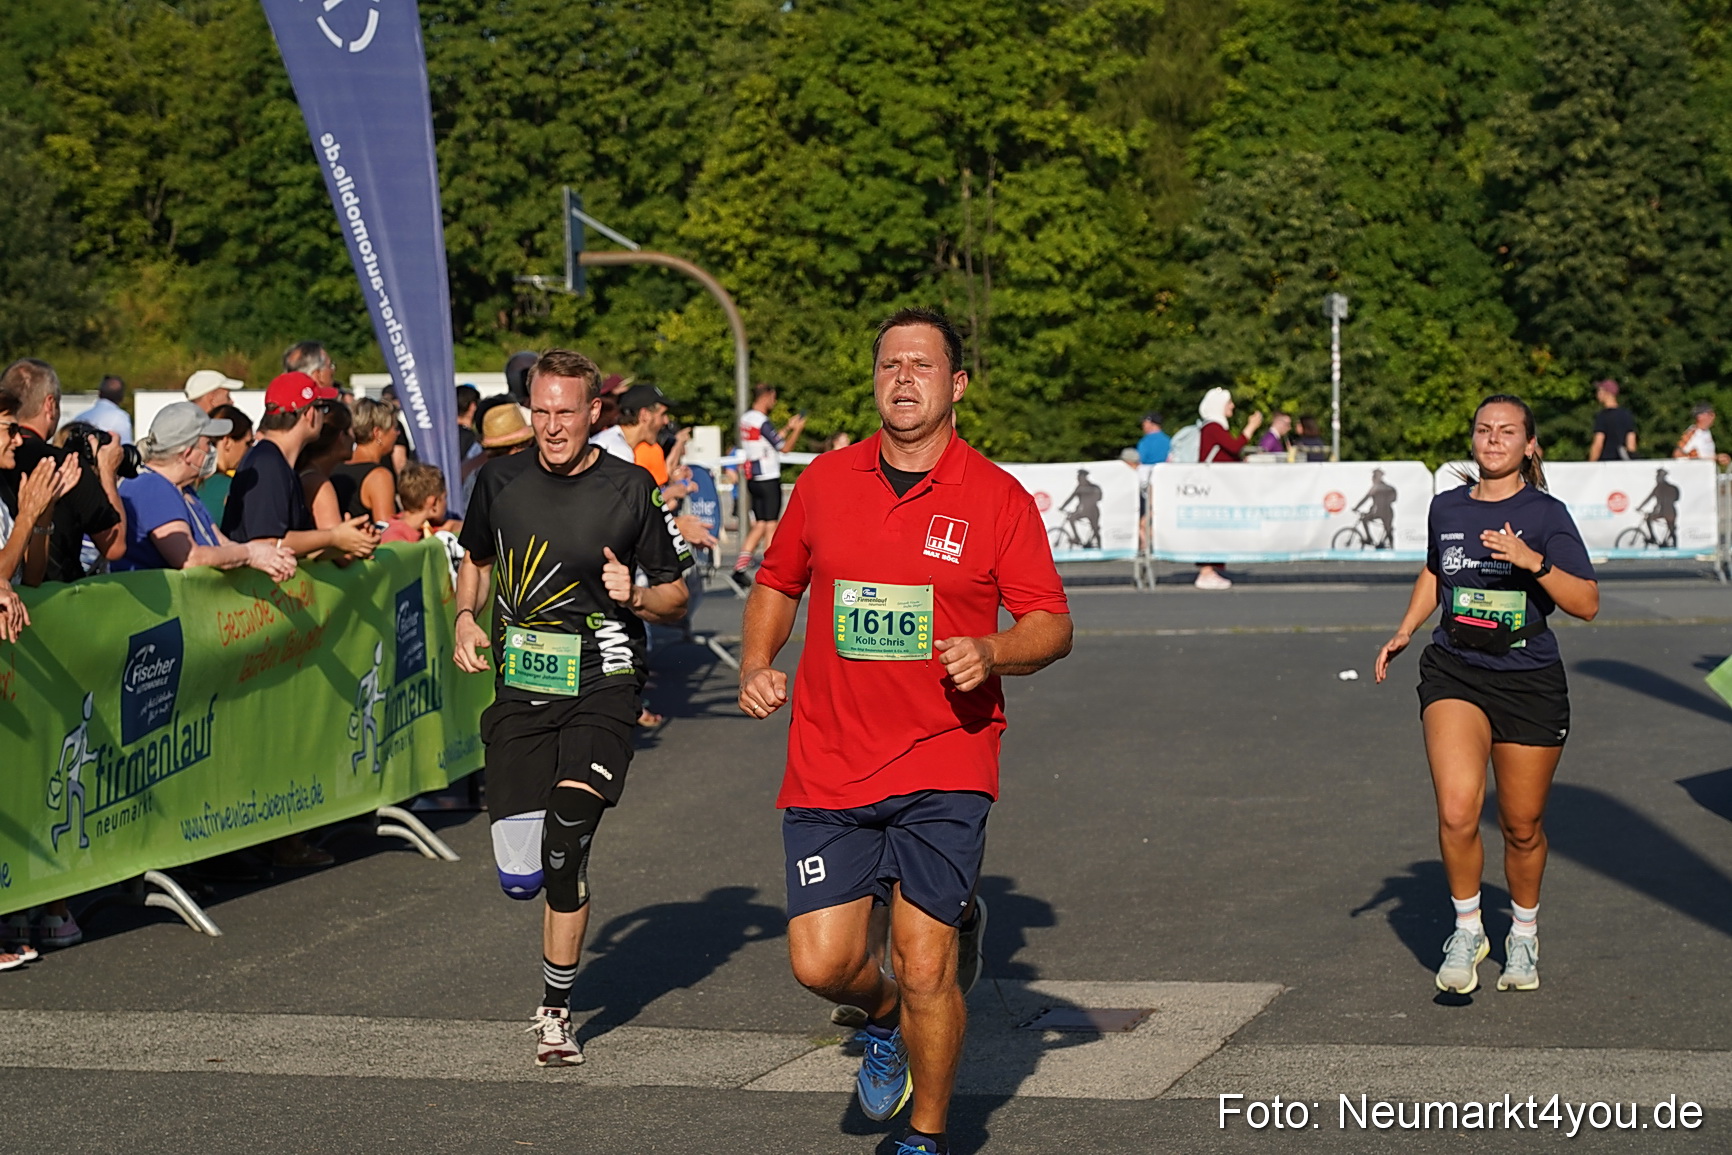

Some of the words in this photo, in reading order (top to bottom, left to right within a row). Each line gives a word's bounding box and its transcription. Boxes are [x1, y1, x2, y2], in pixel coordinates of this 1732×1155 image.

[837, 615, 846, 641] RUN
[848, 608, 916, 636] 1616
[917, 615, 928, 650] 2022
[855, 635, 877, 645] Kolb
[879, 637, 905, 646] Chris
[132, 657, 175, 685] Fischer
[508, 653, 516, 675] RUN
[522, 651, 558, 674] 658
[566, 659, 576, 687] 2022
[95, 692, 219, 808] firmenlauf
[96, 794, 152, 838] neumarkt
[796, 855, 826, 886] 19
